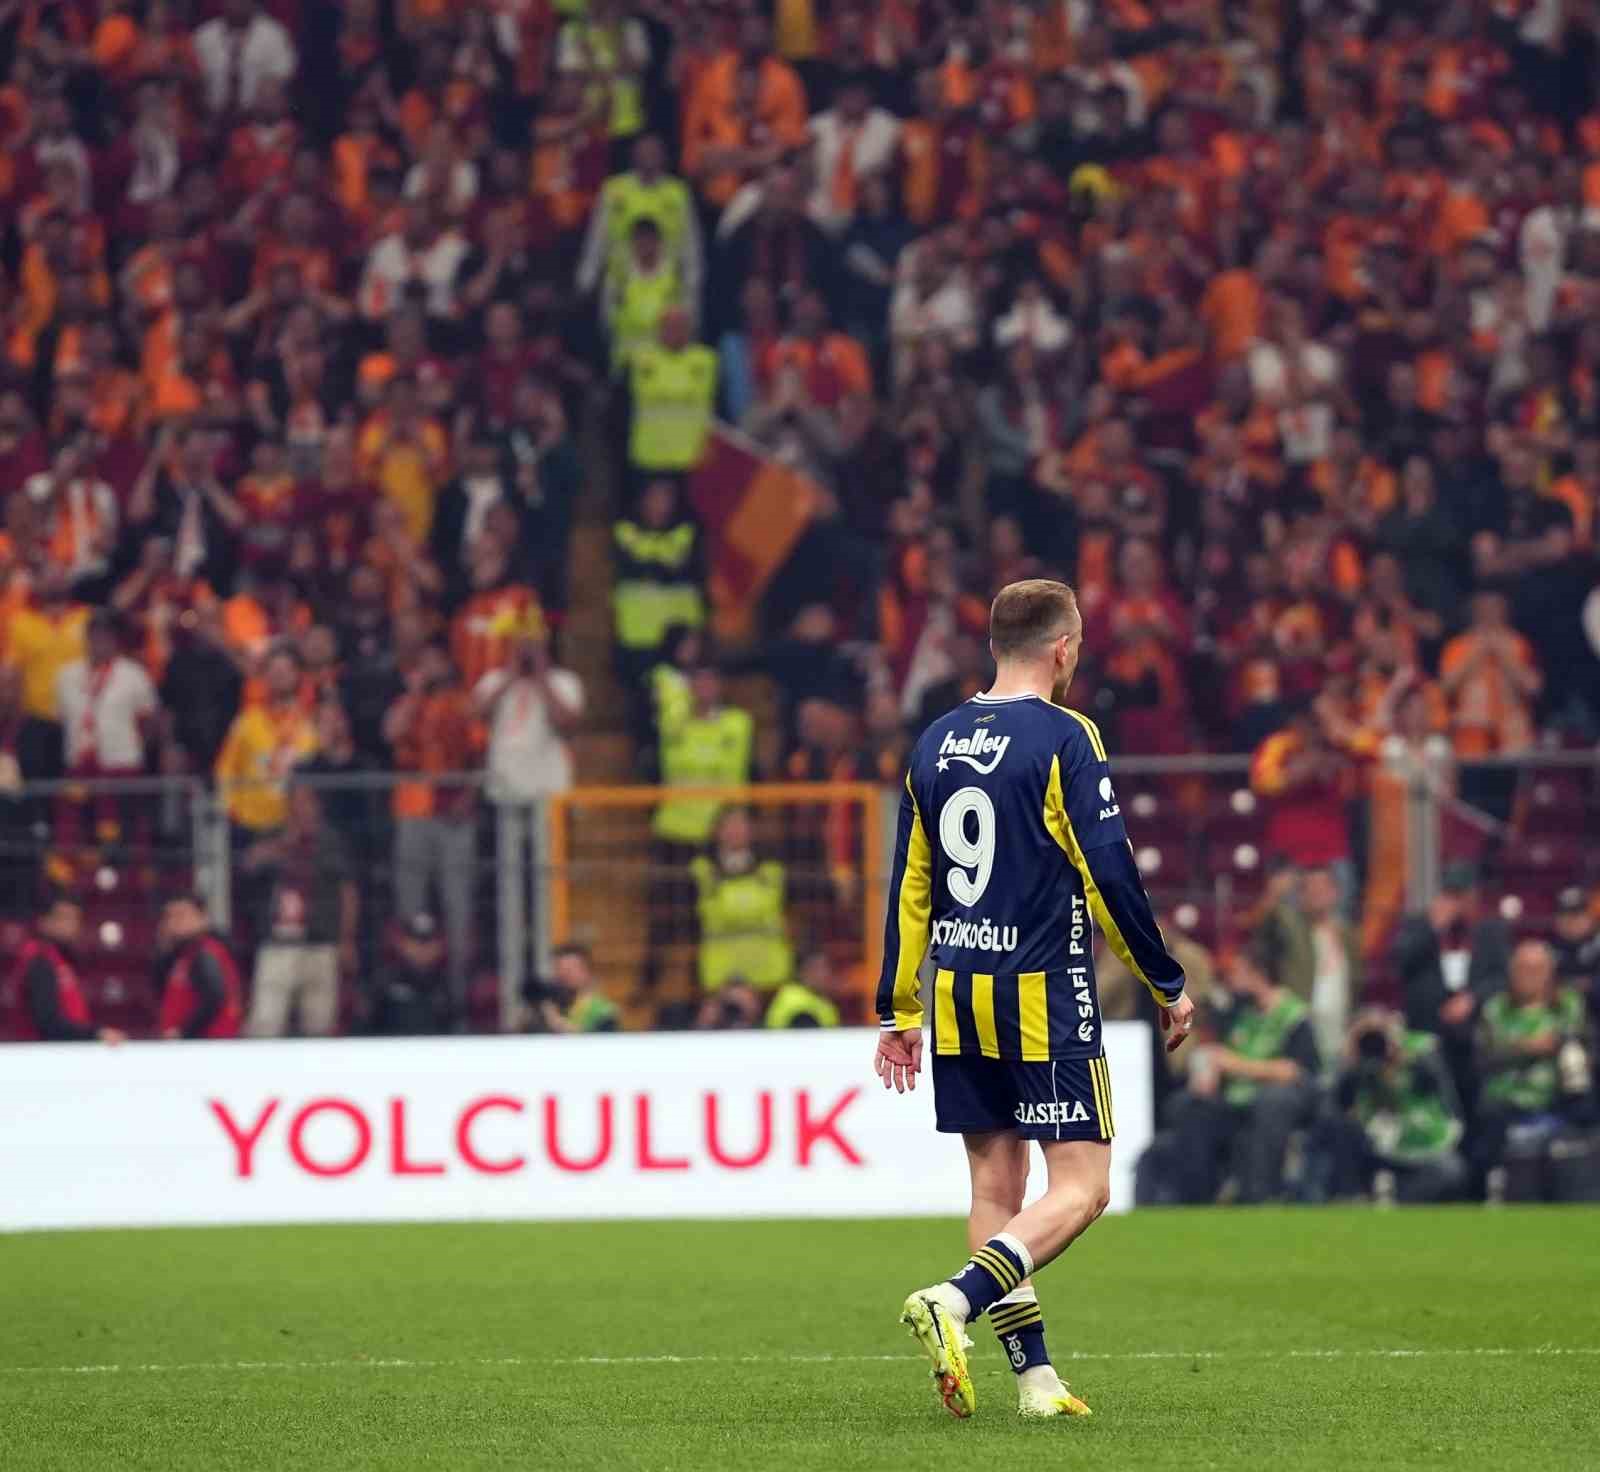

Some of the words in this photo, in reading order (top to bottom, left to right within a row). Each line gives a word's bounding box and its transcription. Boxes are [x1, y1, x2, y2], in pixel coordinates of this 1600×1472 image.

[936, 728, 1011, 774] halley
[939, 786, 996, 907] 9
[1069, 894, 1084, 955] PORT
[207, 1086, 866, 1178] YOLCULUK
